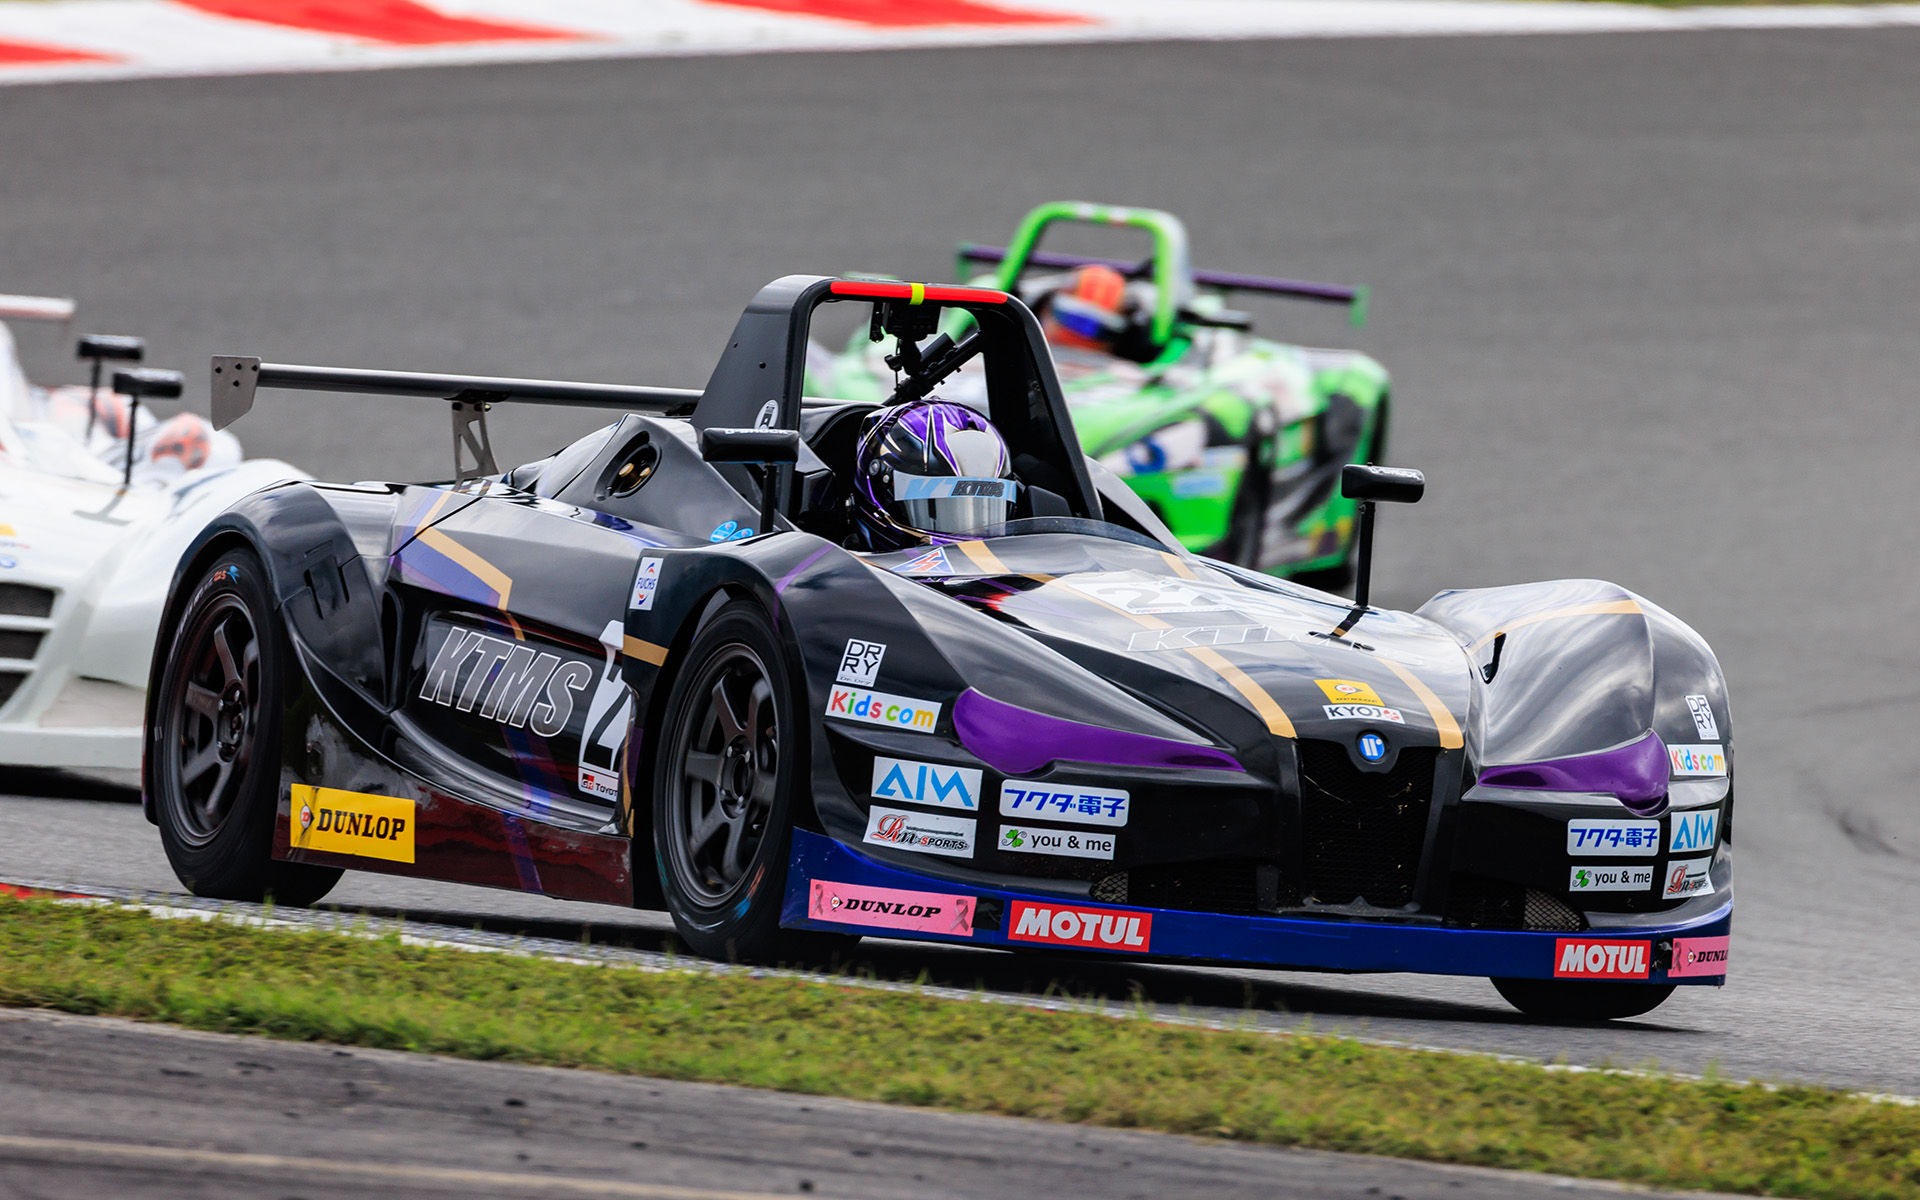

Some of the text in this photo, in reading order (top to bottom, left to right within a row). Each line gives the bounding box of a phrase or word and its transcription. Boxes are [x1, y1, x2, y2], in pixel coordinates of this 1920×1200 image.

[419, 626, 593, 737] KTMS
[831, 691, 934, 727] Kids com
[1671, 749, 1699, 770] Kids
[595, 783, 618, 797] TOYOT
[875, 763, 974, 807] AIM
[1004, 788, 1125, 817] フクダ電子
[316, 808, 405, 840] DUNLOP
[1570, 828, 1658, 847] フクダ電子
[1672, 814, 1713, 849] AIM
[1032, 834, 1111, 851] you & me
[1595, 871, 1650, 886] you & me
[844, 899, 941, 918] DUNLOP
[1015, 907, 1144, 946] MOTUL
[1559, 945, 1646, 973] MOTUL
[1696, 950, 1728, 962] DUNL
